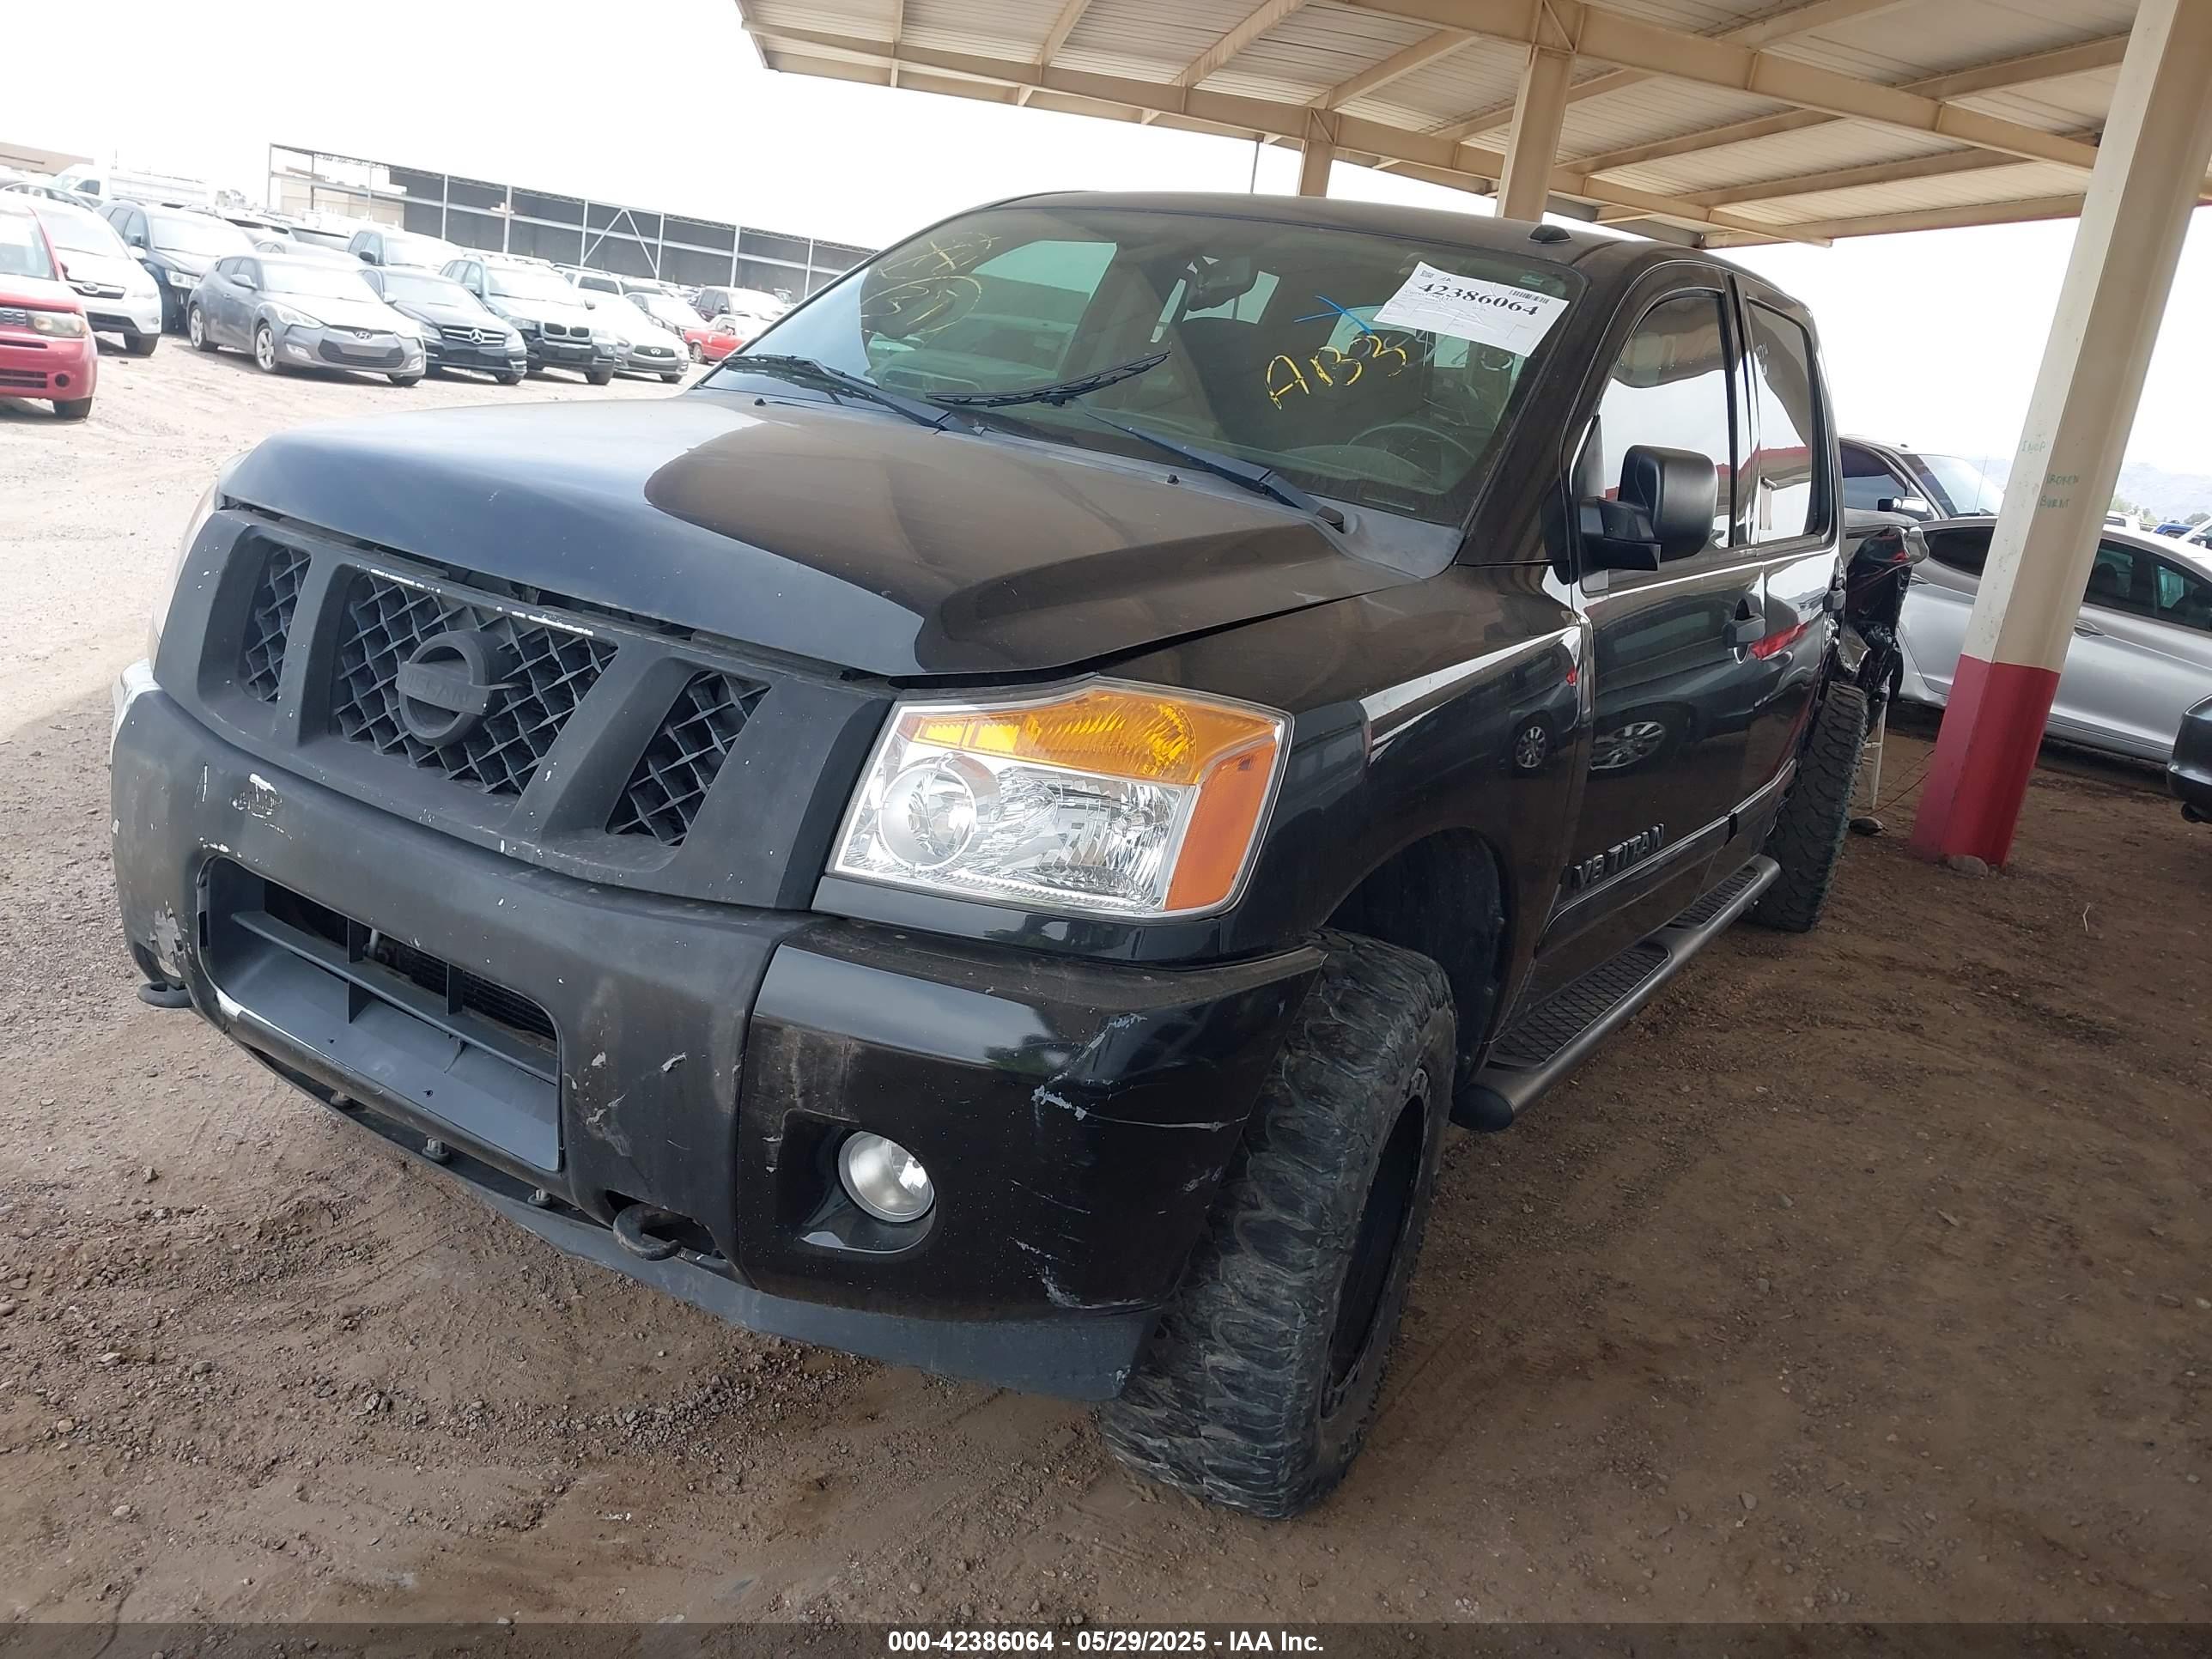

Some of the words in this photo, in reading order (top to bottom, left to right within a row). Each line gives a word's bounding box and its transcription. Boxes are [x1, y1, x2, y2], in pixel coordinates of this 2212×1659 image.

[1418, 283, 1540, 316] 42386064
[1573, 854, 1604, 888] V8
[1607, 823, 1665, 871] TITAN
